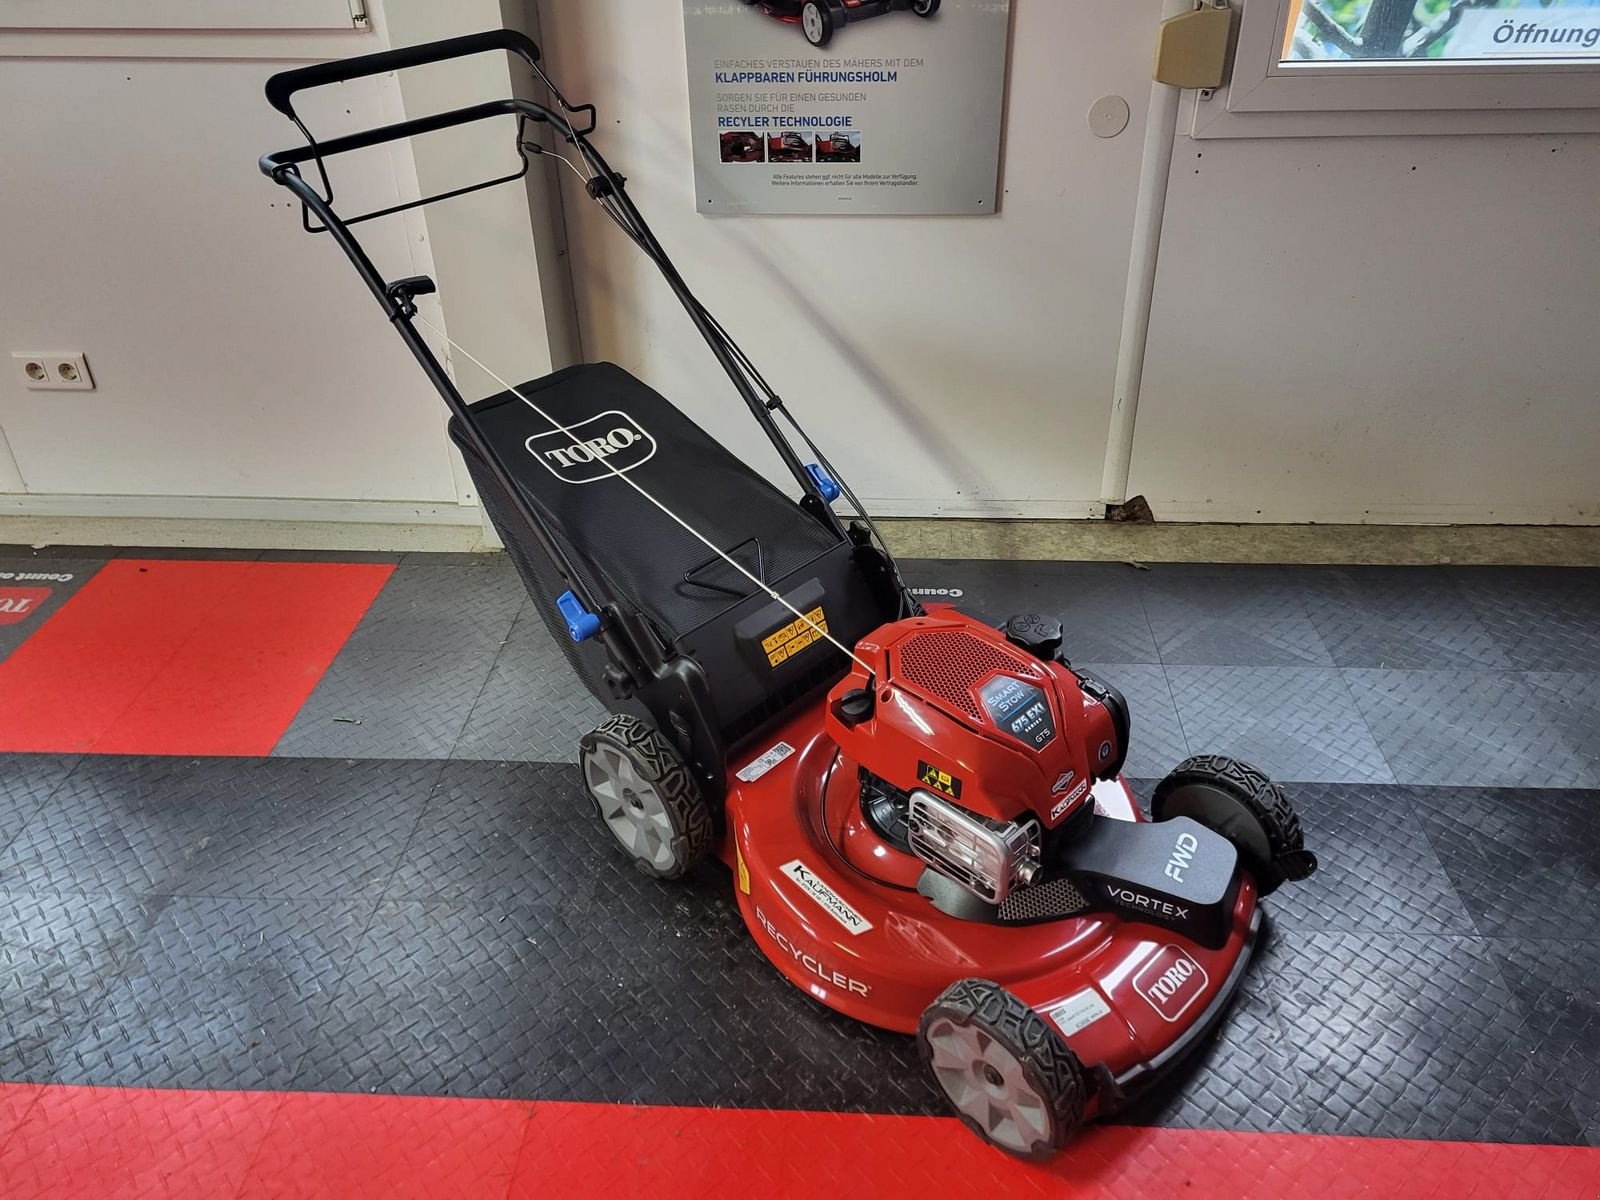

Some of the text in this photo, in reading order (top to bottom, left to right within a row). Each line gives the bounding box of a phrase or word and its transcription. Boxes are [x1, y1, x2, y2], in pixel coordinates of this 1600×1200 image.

[714, 57, 924, 69] EINFACHES VERSTAUEN DES MÄHERS MIT DEM
[715, 69, 897, 83] KLAPPBAREN FÜHRUNGSHOLM
[717, 92, 867, 102] SORGEN SIE FÜR EINEN GESUNDEN
[717, 104, 795, 112] RASEN DURCH DIE
[718, 116, 852, 127] RECYLER TECHNOLOGIE
[544, 428, 634, 468] TORO
[15, 573, 73, 582] Count
[988, 681, 1020, 706] SMART
[999, 690, 1025, 712] STOW
[1011, 714, 1030, 733] 675
[1035, 728, 1051, 743] GTS
[1165, 833, 1198, 883] FWD
[793, 865, 860, 927] KAUFMANN
[1107, 885, 1189, 919] VORTEX
[756, 906, 869, 998] RECYCLER
[1148, 958, 1194, 1004] TORO
